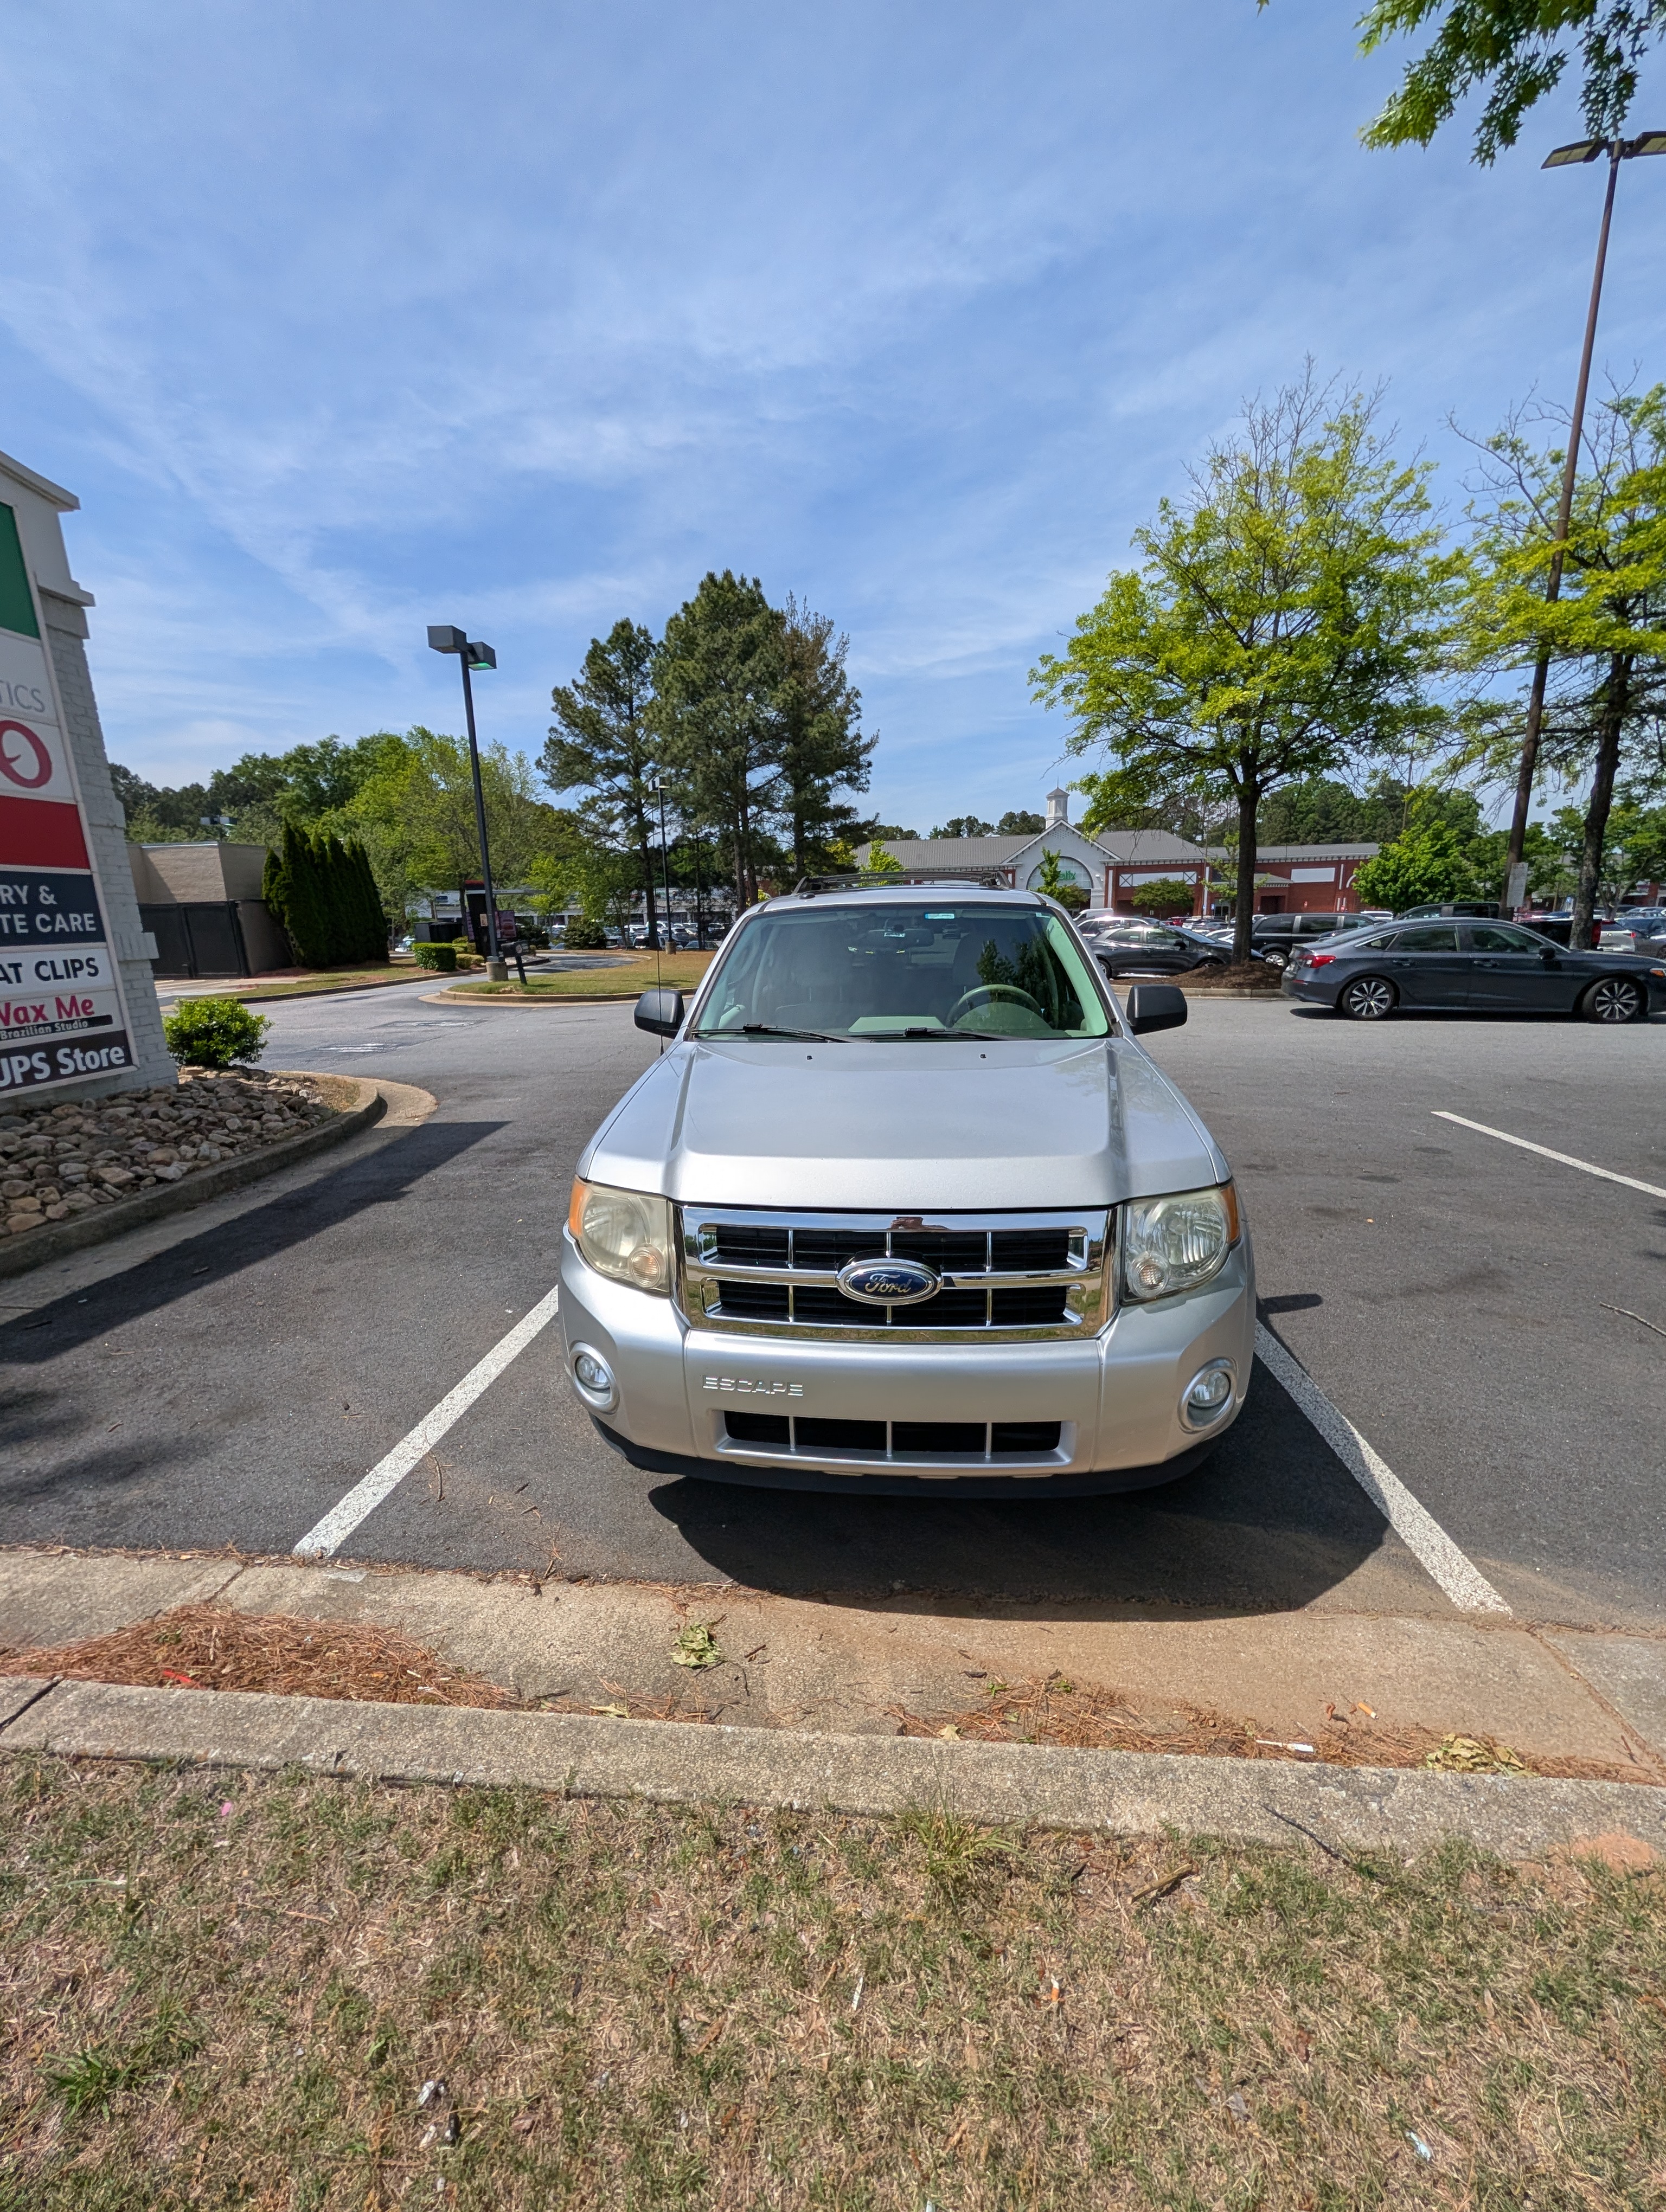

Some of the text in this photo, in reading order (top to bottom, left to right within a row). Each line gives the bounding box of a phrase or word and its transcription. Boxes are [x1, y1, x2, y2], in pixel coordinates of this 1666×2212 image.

[39, 885, 58, 905] &
[35, 913, 96, 933] CARE
[34, 957, 99, 981] CLIPS
[55, 995, 94, 1019] Me
[1, 1020, 88, 1040] Brazilian Studio
[56, 1046, 125, 1075] Store
[865, 1274, 912, 1293] Ford
[702, 1375, 803, 1396] ESCAPE
